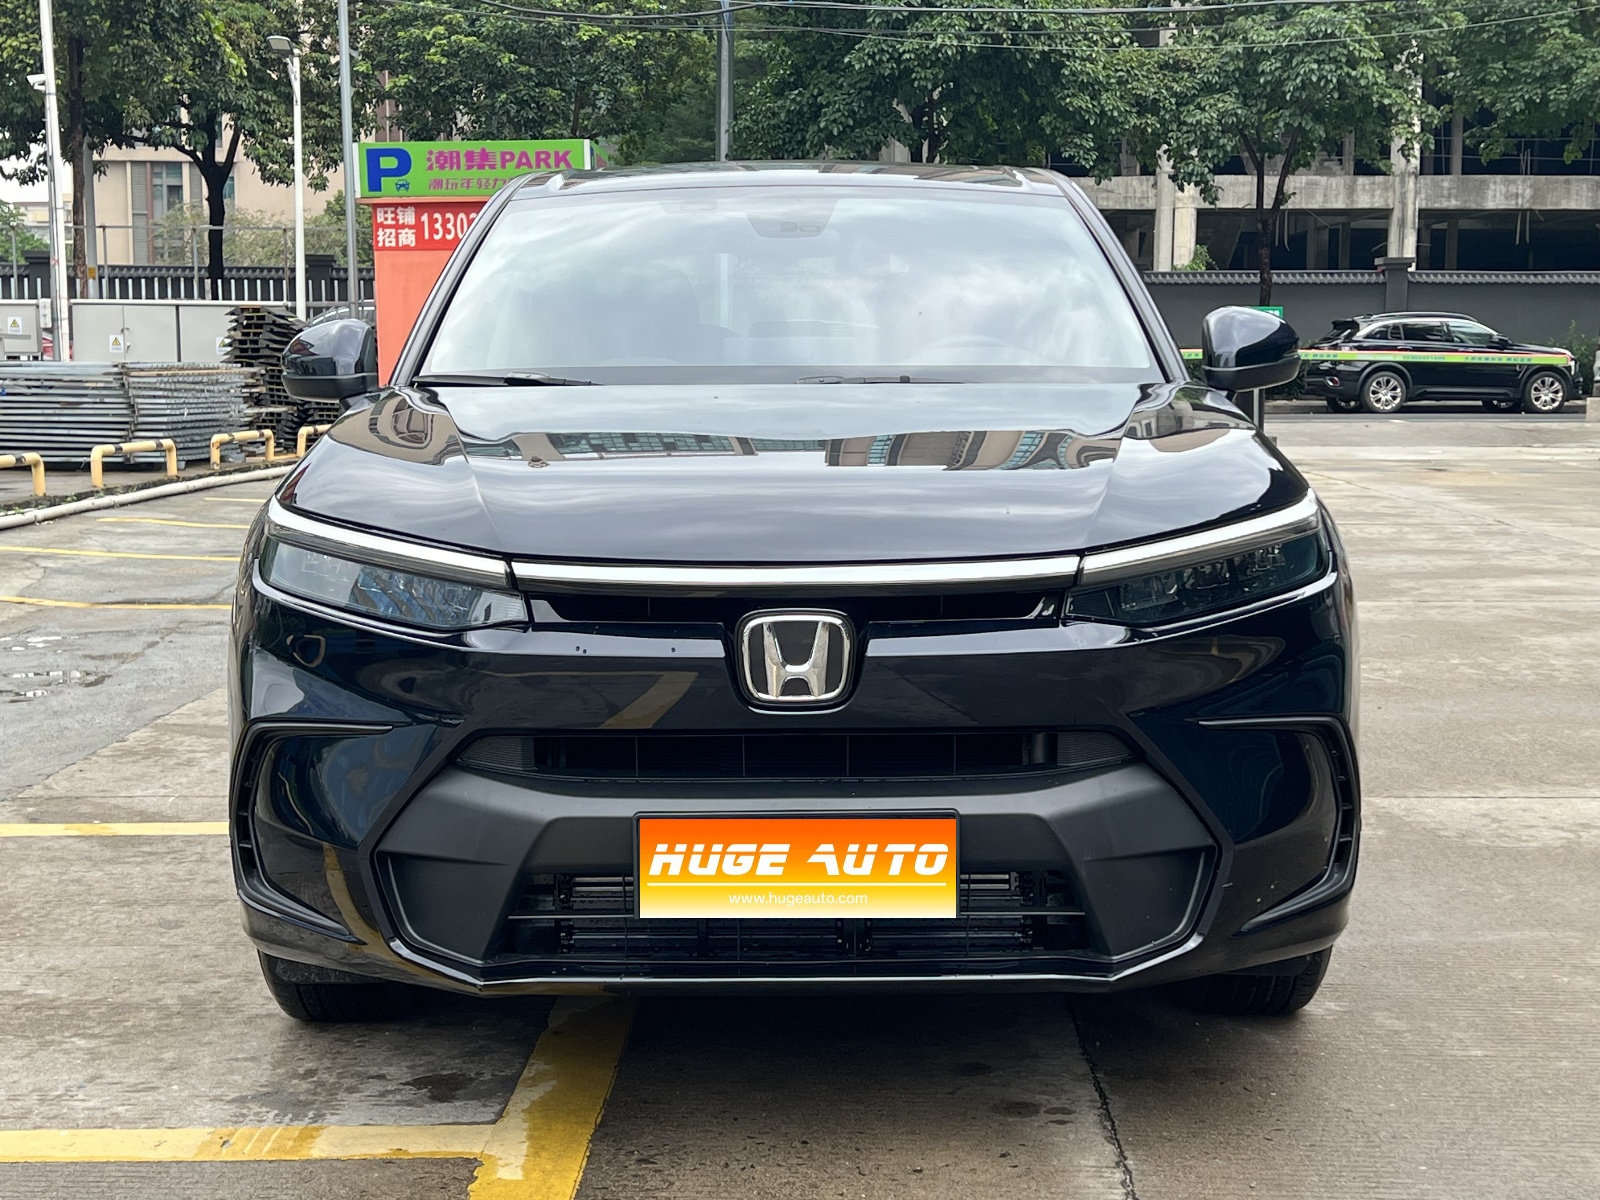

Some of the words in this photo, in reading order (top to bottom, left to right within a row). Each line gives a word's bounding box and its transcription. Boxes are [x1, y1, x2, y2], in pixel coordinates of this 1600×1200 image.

[365, 148, 412, 193] P
[428, 177, 512, 191] 潮玩年轻力
[376, 206, 416, 226] 旺铺
[377, 228, 416, 248] 招商
